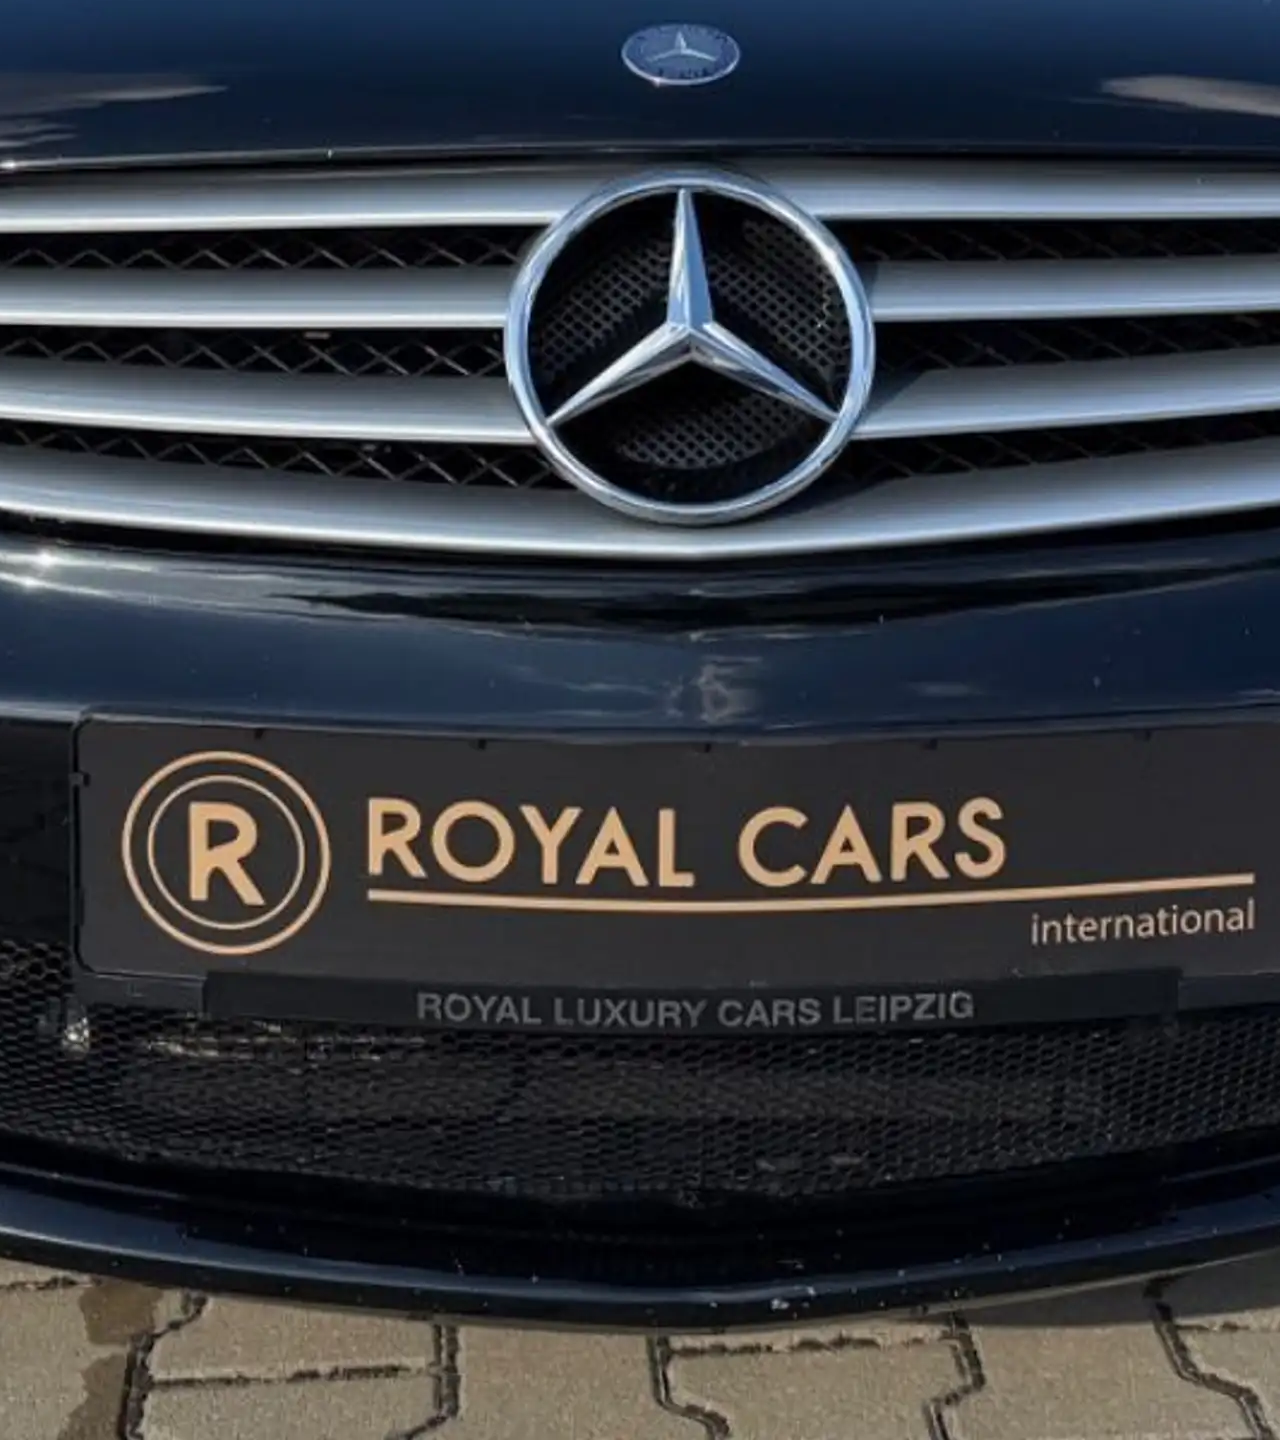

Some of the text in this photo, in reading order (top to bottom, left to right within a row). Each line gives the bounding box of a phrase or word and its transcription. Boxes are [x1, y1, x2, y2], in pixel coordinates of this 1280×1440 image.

[188, 801, 267, 906] R
[367, 796, 1007, 888] ROYAL CARS
[1031, 898, 1257, 946] international
[416, 990, 975, 1029] ROYAL LUXURY CARS LEIPZIG
